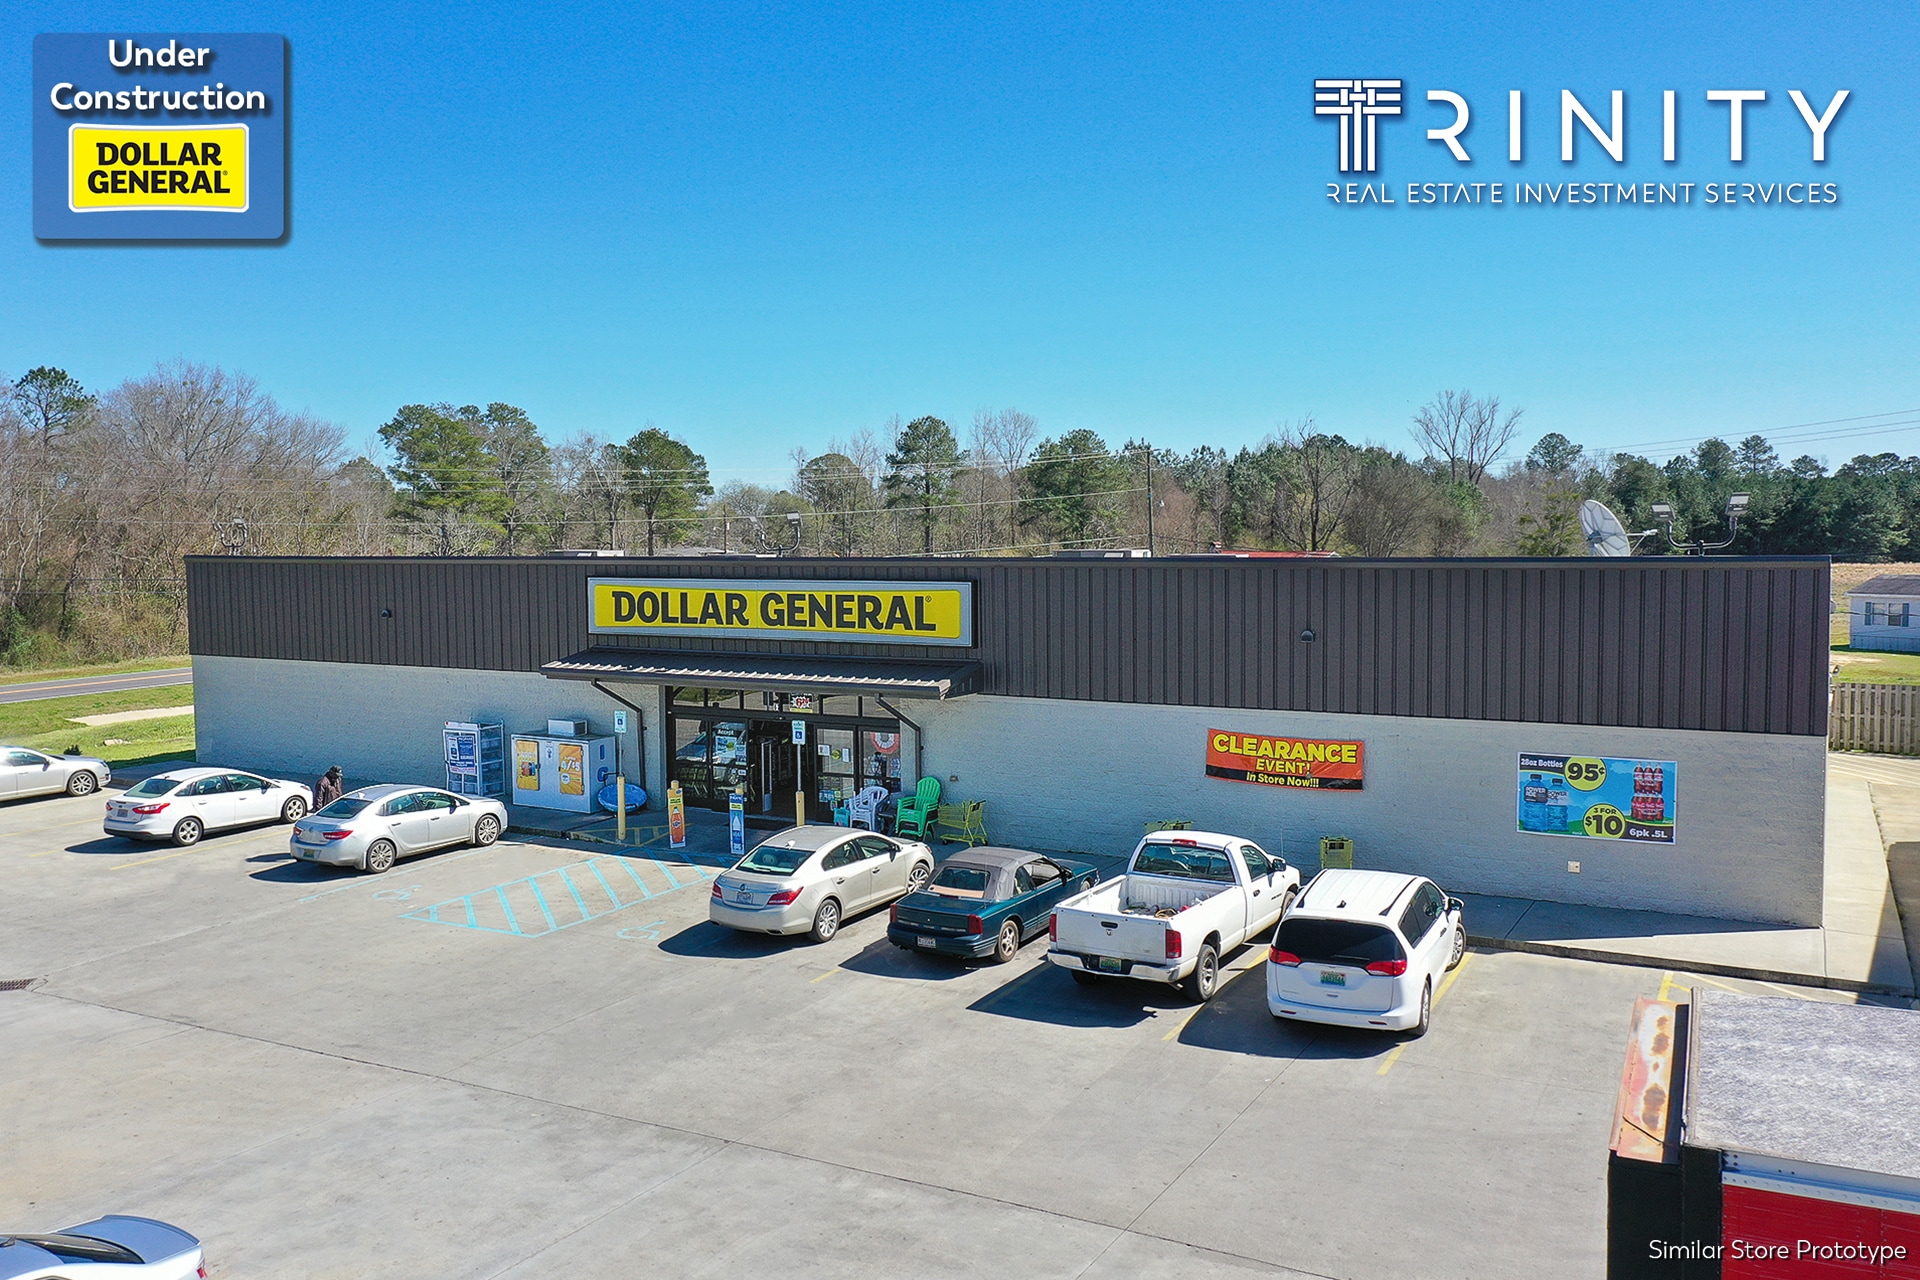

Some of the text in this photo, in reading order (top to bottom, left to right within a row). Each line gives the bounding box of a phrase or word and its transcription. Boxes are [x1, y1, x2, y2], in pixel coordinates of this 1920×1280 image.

[611, 591, 750, 626] DOLLAR
[1213, 734, 1357, 763] CLEARANCE
[1255, 758, 1311, 775] EVENT!
[1538, 759, 1563, 768] Bottles
[1246, 772, 1320, 788] In Store Now!!!
[1585, 814, 1623, 835] $10
[1629, 828, 1650, 838] 6pk
